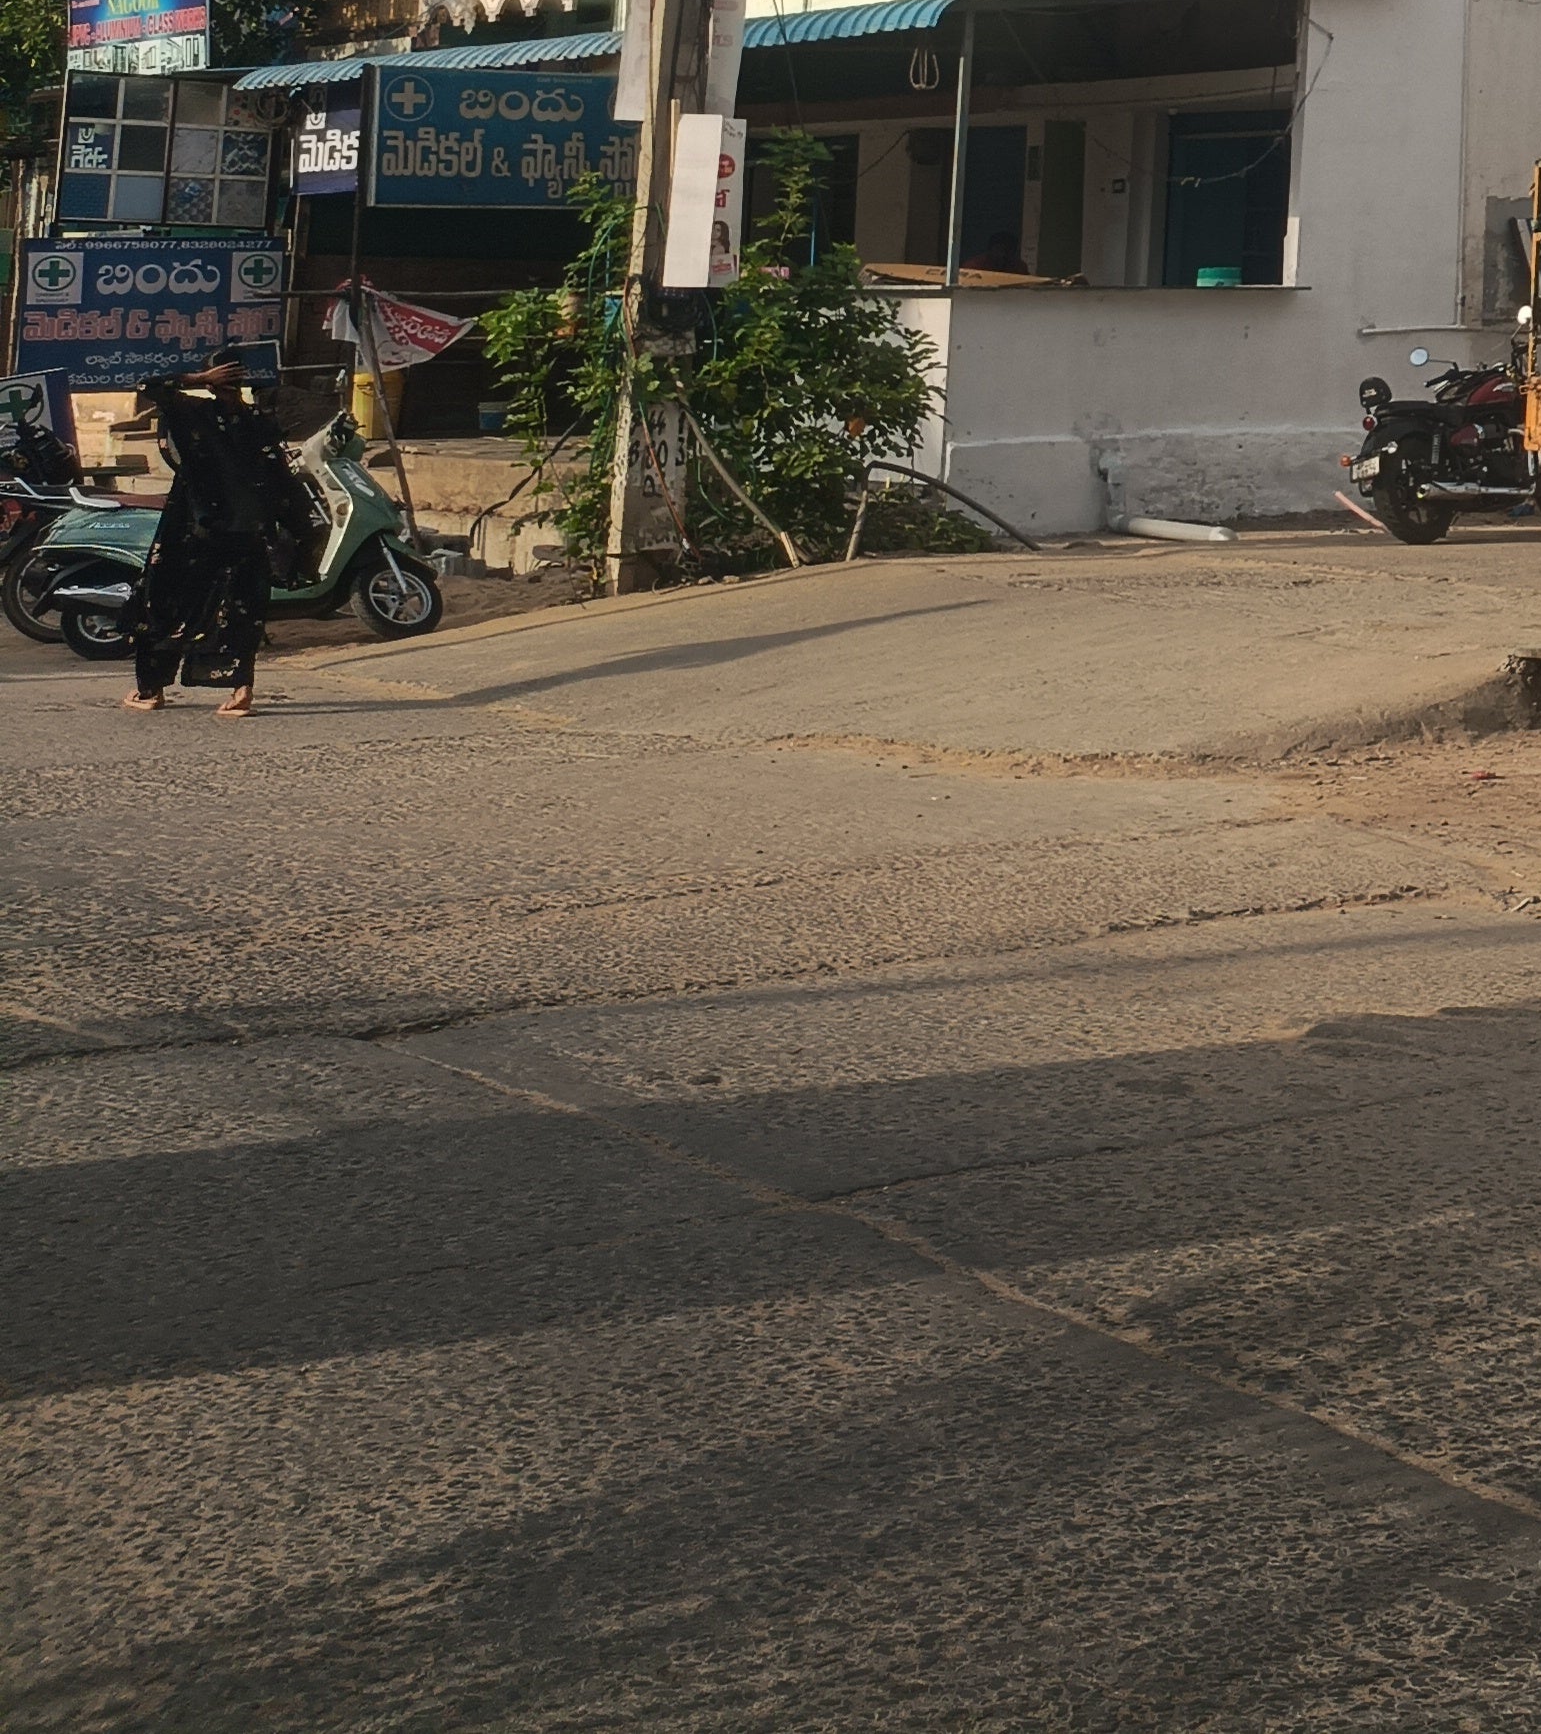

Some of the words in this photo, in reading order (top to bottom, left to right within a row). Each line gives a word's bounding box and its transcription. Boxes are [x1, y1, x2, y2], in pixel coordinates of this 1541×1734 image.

[459, 87, 584, 122] బిందు
[298, 128, 360, 173] మెడిక
[381, 126, 486, 178] మెడికల్
[491, 145, 511, 178] &
[96, 258, 221, 295] బిందు
[23, 307, 124, 341] మెడికల్
